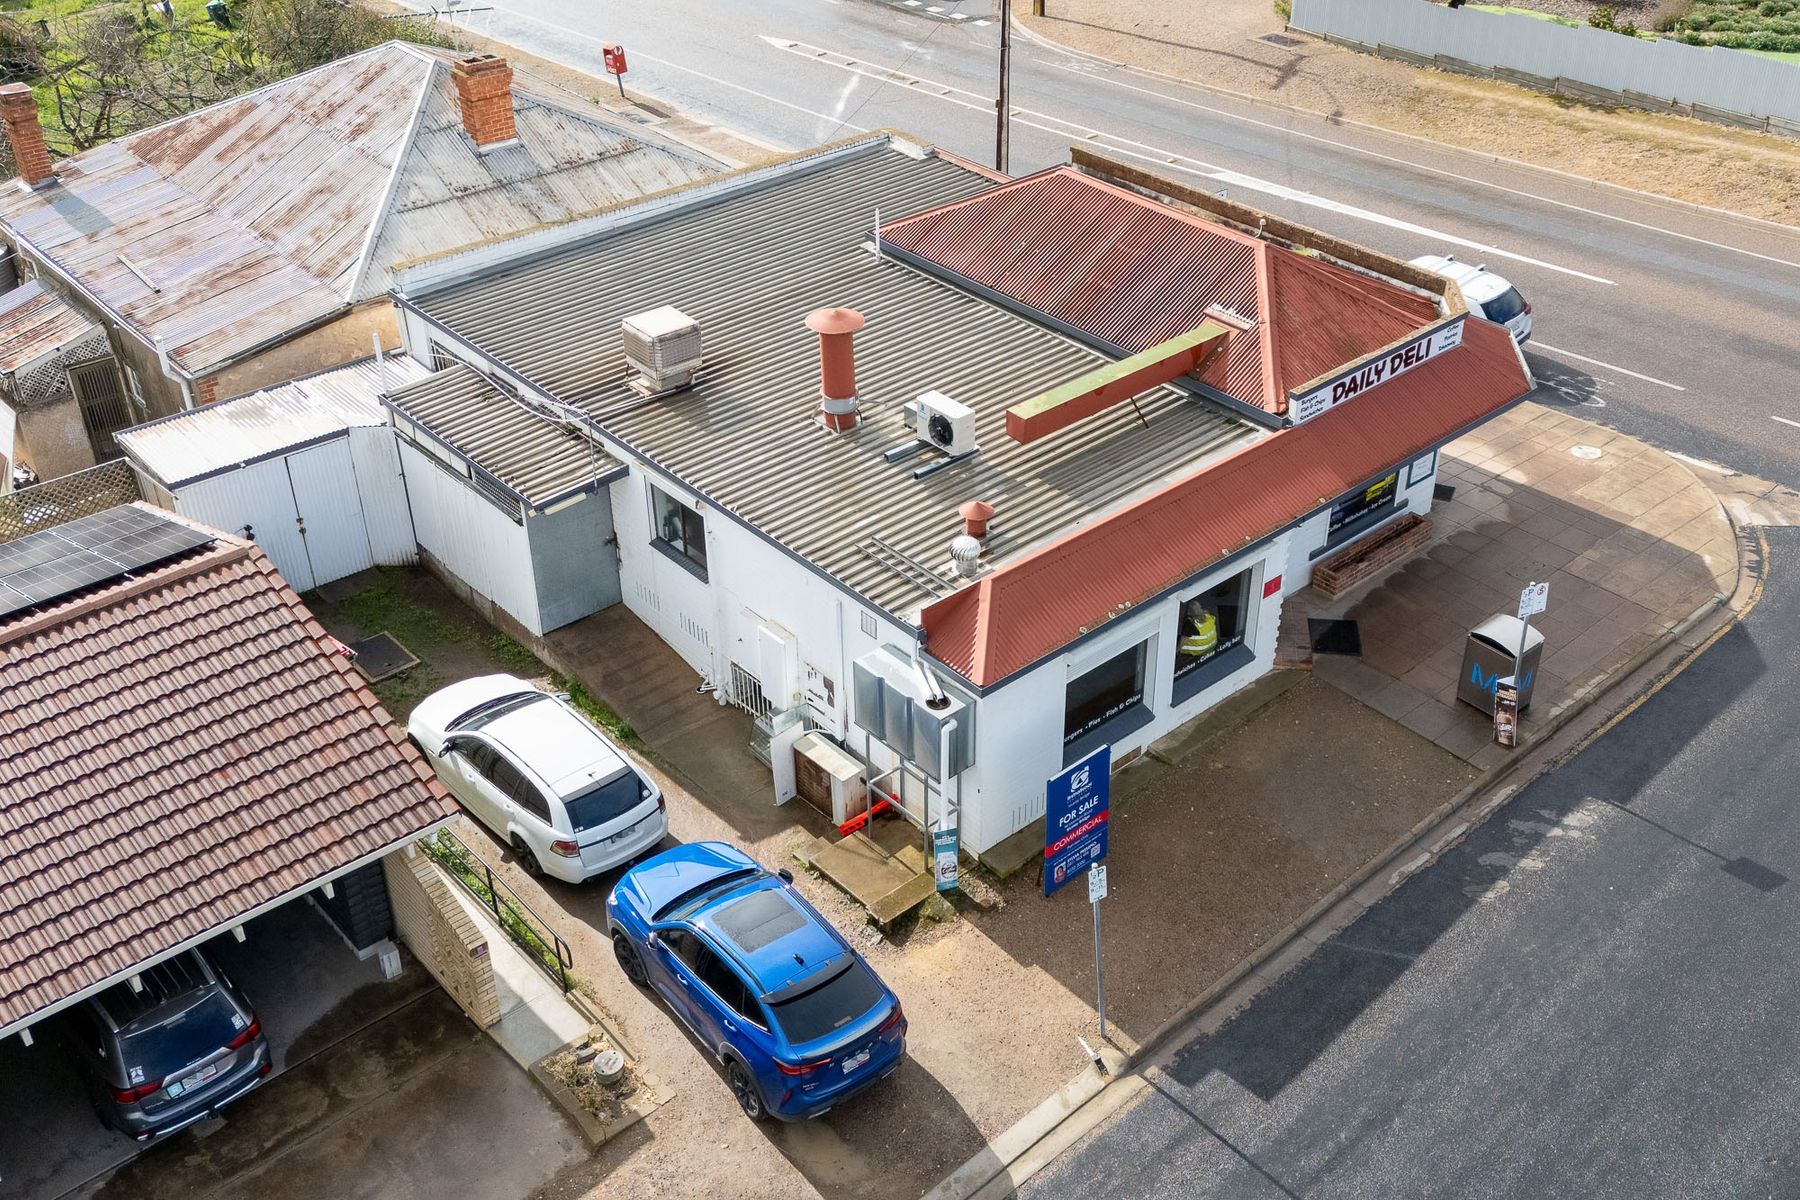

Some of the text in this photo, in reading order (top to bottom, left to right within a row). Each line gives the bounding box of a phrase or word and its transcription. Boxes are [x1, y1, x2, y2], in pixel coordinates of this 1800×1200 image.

[1332, 337, 1432, 404] DAILY DELI
[1089, 717, 1101, 728] Pies
[1106, 706, 1119, 718] Fish
[1126, 694, 1141, 707] Chips
[1059, 809, 1077, 827] FOR
[1079, 795, 1099, 815] SALE
[1054, 816, 1102, 851] COMMERCIAL
[1097, 868, 1104, 877] P
